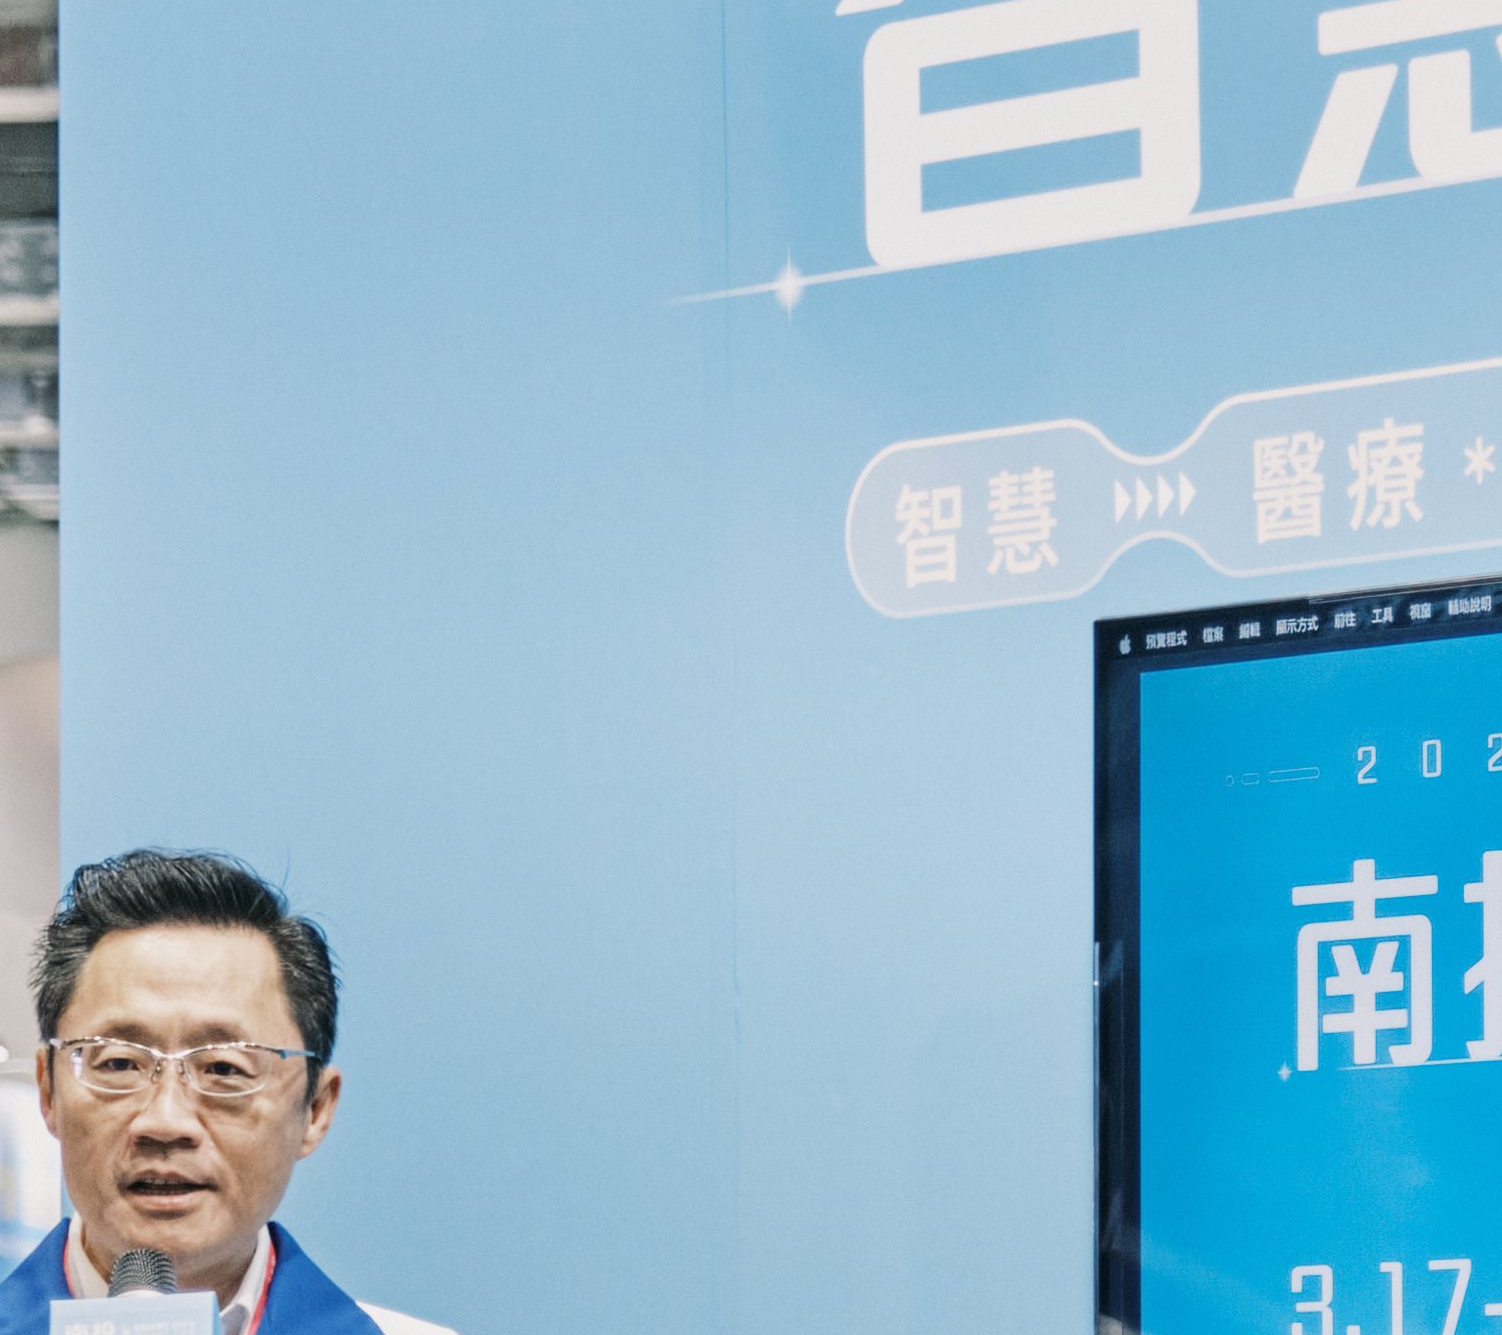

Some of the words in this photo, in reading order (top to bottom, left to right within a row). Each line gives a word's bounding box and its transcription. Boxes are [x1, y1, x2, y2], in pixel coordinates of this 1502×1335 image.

[895, 467, 1061, 590] 智慧
[1251, 418, 1427, 546] 醫療
[1372, 607, 1394, 624] 工具
